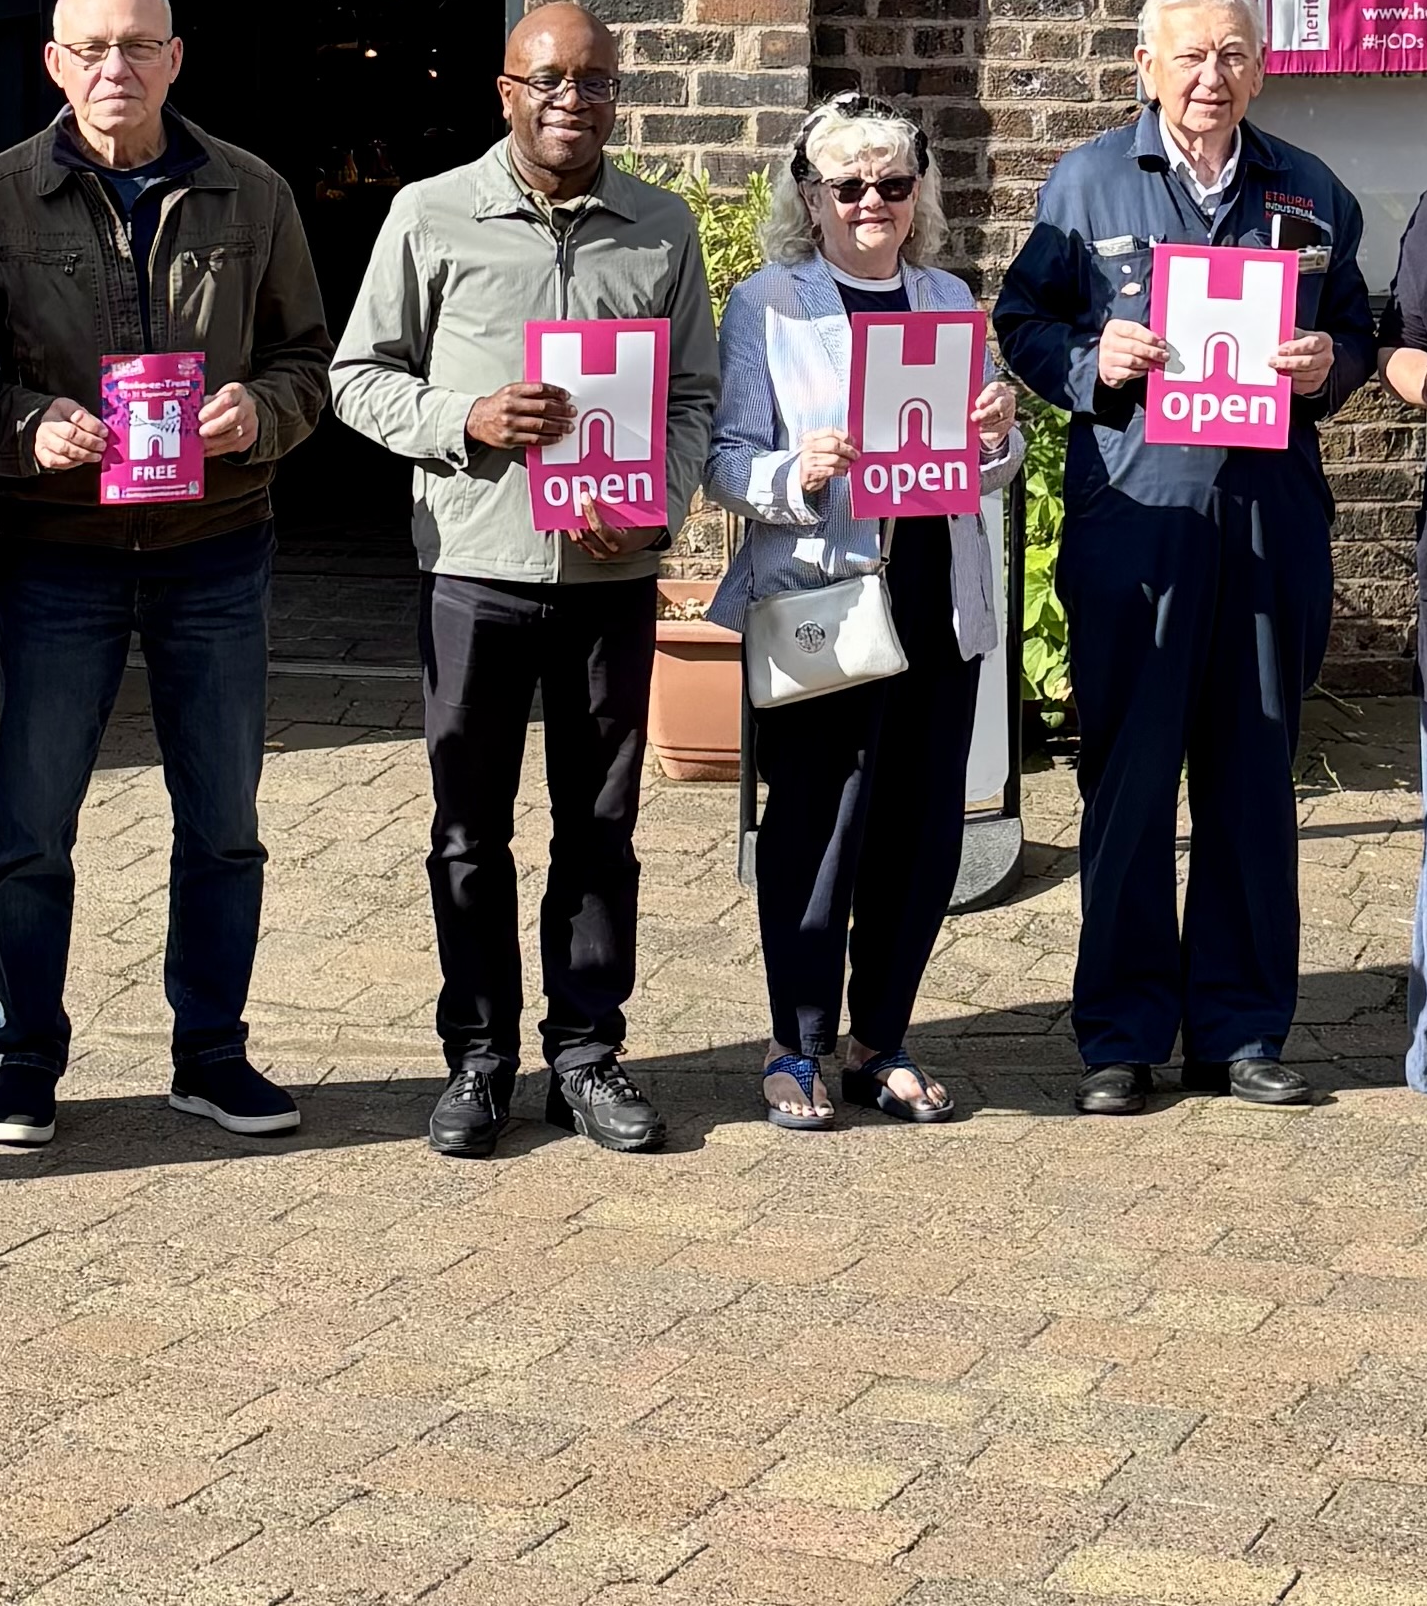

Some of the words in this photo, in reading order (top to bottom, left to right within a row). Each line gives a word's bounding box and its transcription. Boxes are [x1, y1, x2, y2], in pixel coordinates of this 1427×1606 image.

[1362, 33, 1423, 49] #HODs
[1265, 191, 1314, 209] ETRURIA
[1161, 392, 1276, 432] open
[132, 464, 177, 480] FREE
[863, 460, 968, 504] open
[543, 471, 653, 517] open
